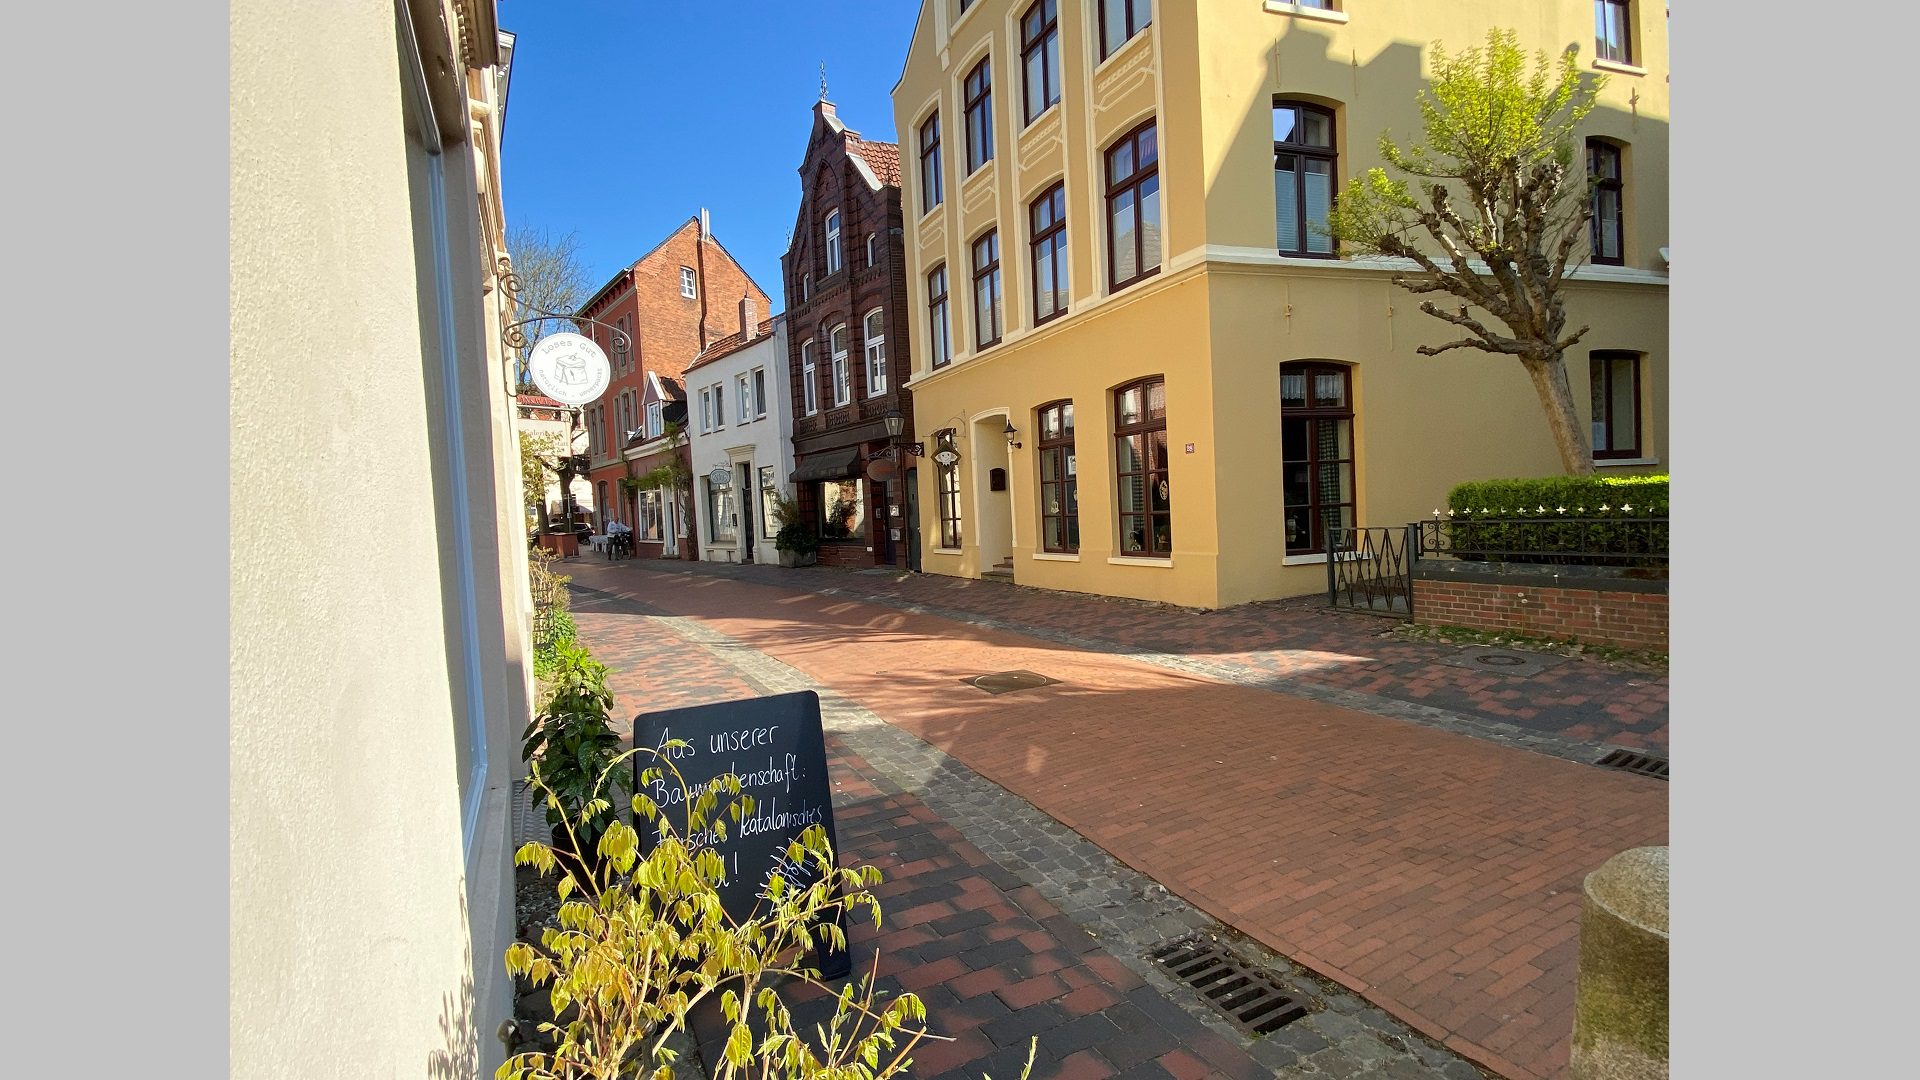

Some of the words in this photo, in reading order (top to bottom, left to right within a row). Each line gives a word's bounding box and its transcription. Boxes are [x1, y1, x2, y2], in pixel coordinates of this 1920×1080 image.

[541, 340, 573, 354] Loses
[579, 342, 597, 358] Gut
[652, 727, 696, 762] Aus
[710, 725, 779, 754] unserer
[739, 797, 822, 839] katalanisches
